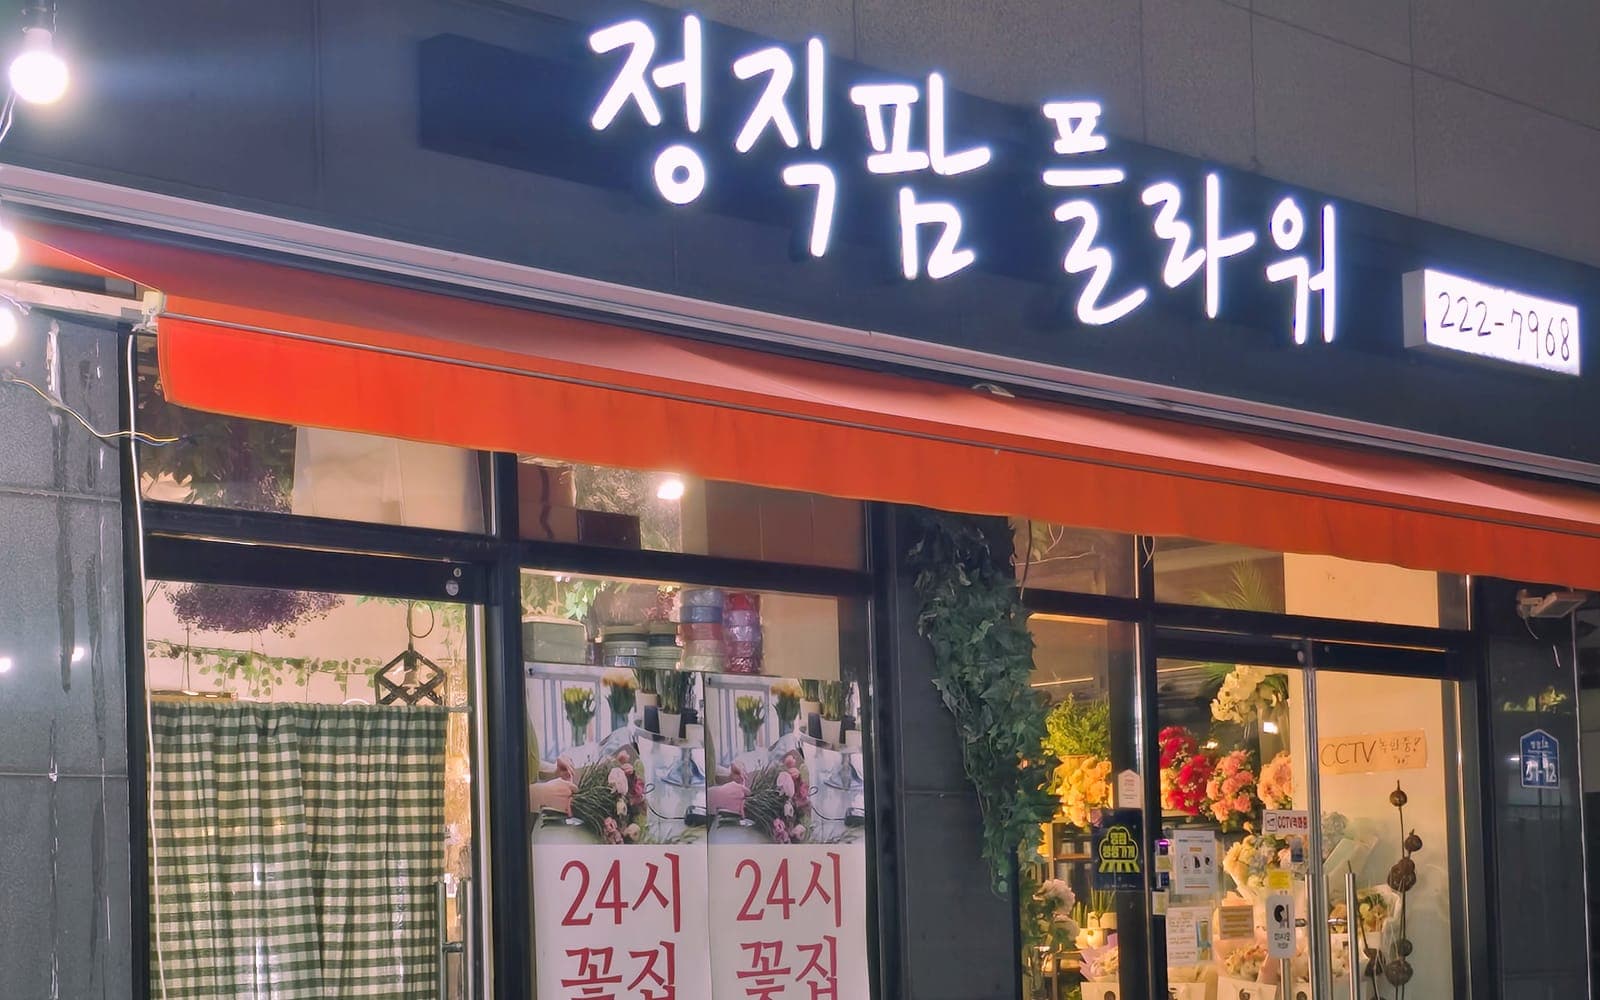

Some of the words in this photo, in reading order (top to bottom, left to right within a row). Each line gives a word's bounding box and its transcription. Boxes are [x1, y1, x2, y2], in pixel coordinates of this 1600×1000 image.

[589, 14, 991, 280] 정직팜
[1043, 101, 1337, 345] 플라워
[1438, 291, 1570, 362] 222-7968
[1320, 740, 1377, 768] CCTV
[560, 852, 681, 933] 24시
[735, 852, 842, 928] 24시
[736, 935, 839, 1000] 꽃집
